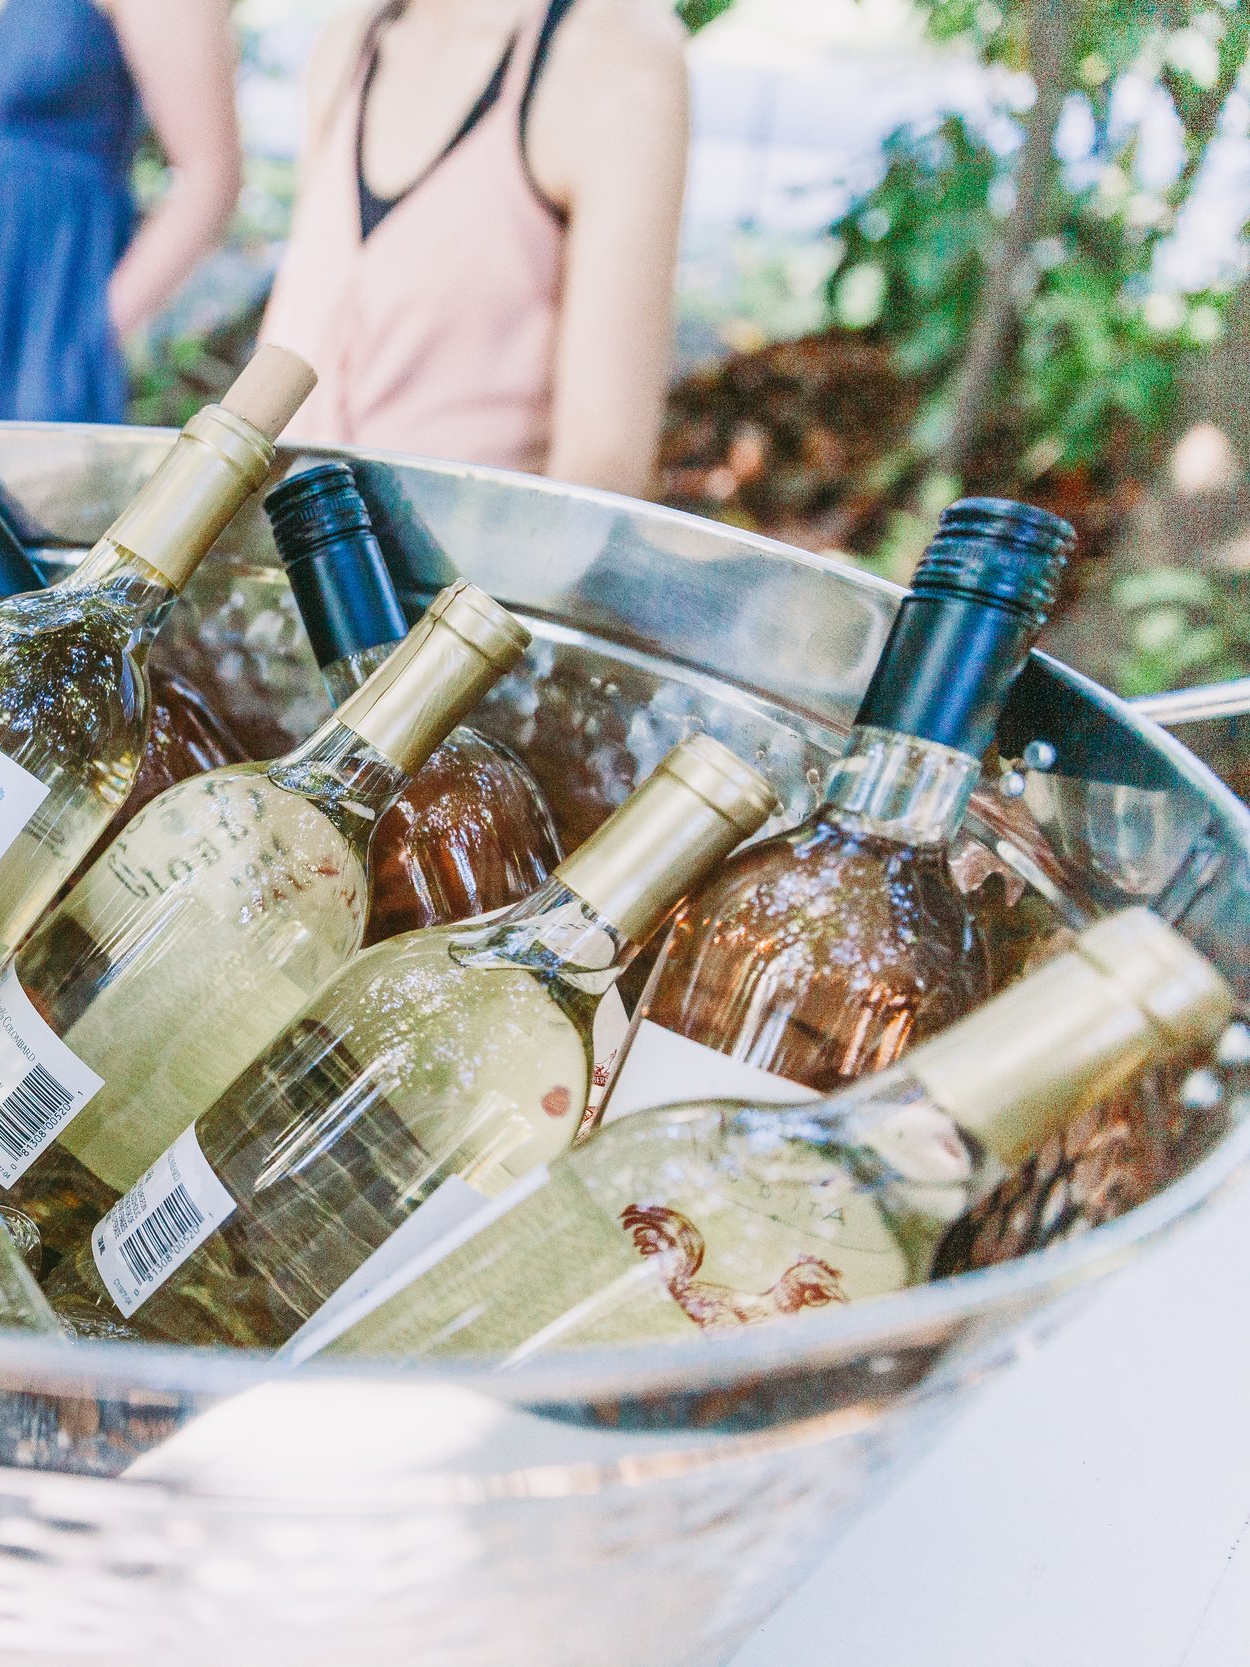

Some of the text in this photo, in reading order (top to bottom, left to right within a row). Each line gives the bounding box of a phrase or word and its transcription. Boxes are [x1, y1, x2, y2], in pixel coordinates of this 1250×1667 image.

[22, 1130, 47, 1157] 81308
[47, 1103, 71, 1130] 00520
[146, 1255, 172, 1282] 81308
[175, 1226, 200, 1255] 00520
